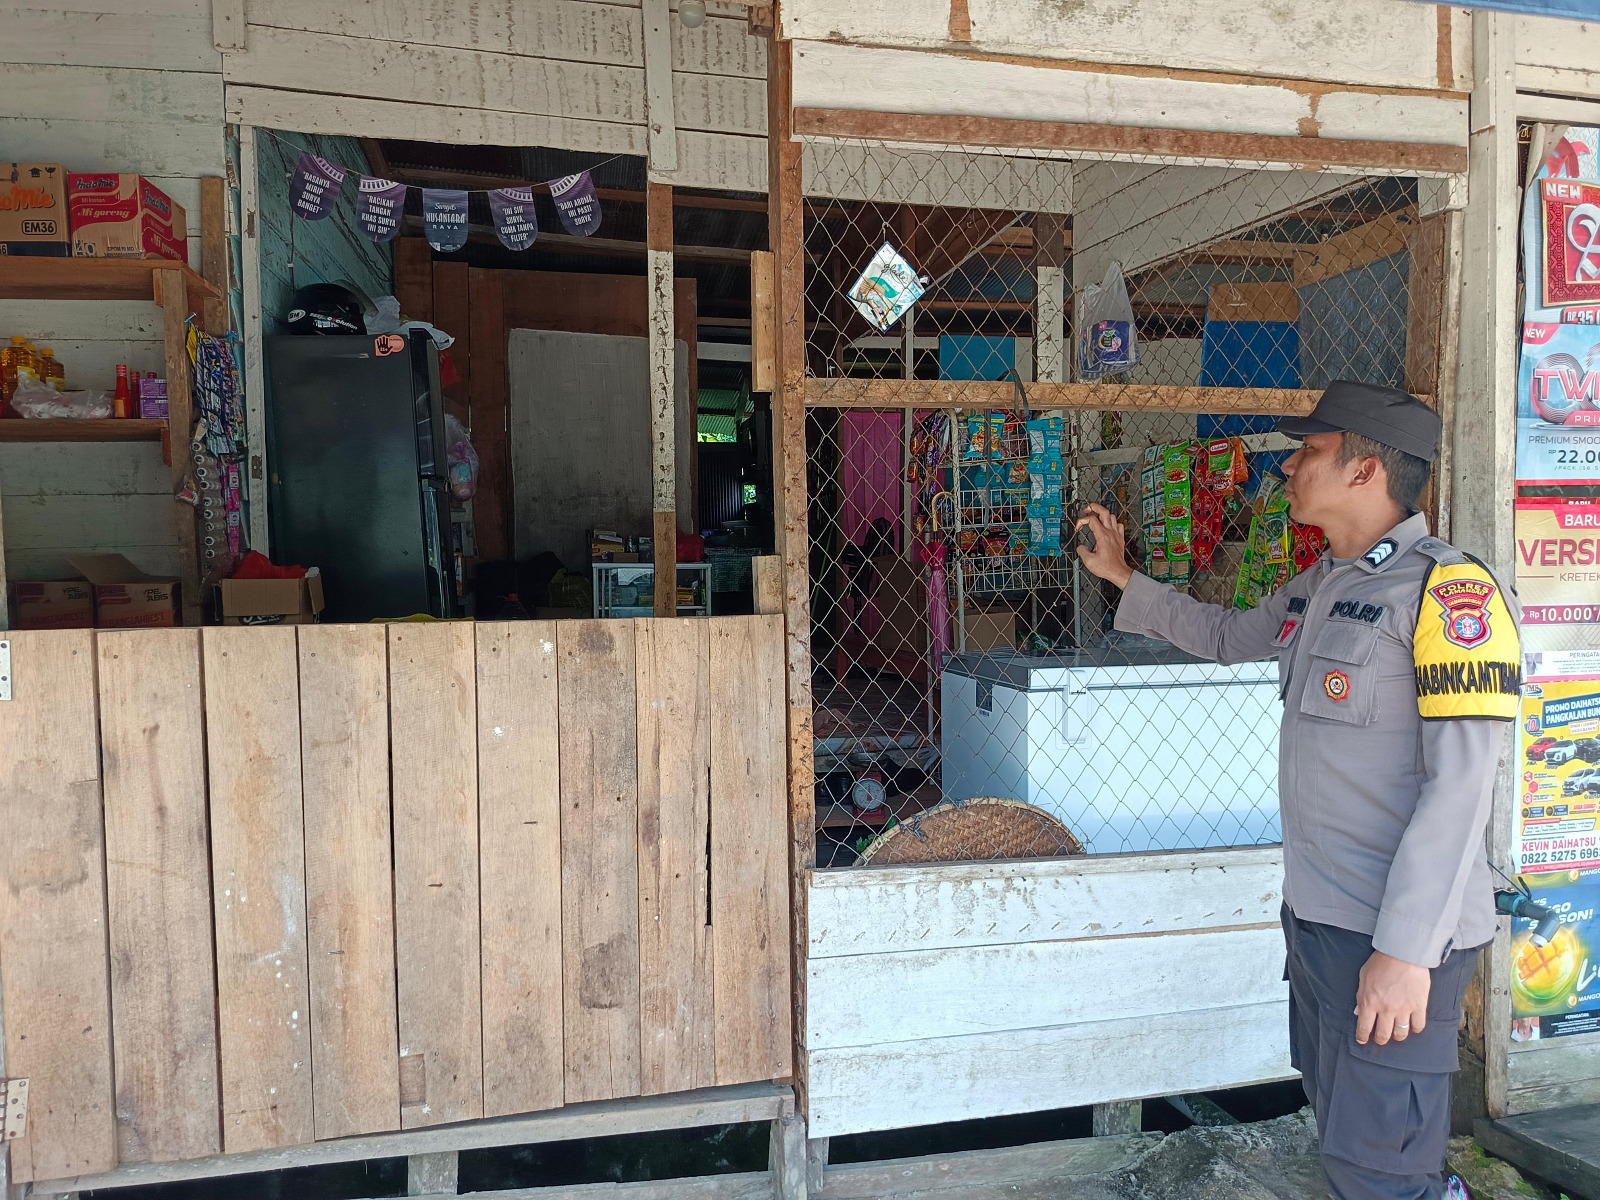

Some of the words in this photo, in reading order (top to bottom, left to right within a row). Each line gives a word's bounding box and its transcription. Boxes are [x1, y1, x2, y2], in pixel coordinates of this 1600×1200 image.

[305, 183, 325, 195] MIRIP
[1545, 182, 1580, 199] NEW
[301, 191, 321, 205] SURYA
[94, 207, 130, 219] goreng
[369, 205, 392, 216] TANGAN
[361, 213, 377, 223] KHAS
[378, 216, 396, 228] SURYA
[426, 212, 466, 224] NUSANTARA
[24, 222, 55, 234] EM36
[367, 223, 377, 232] INI
[1525, 327, 1546, 339] NEW
[1528, 435, 1571, 445] PREMIUM
[1439, 583, 1489, 596] POLRES
[1329, 601, 1384, 623] POLRI
[1529, 610, 1540, 619] Rp
[1545, 702, 1570, 714] PROMO
[1545, 710, 1587, 725] PANGKALAN
[1521, 841, 1549, 852] KEVIN
[1552, 836, 1596, 850] DAIHATSU
[1521, 852, 1547, 864] 0822
[1550, 849, 1577, 862] 5275
[1580, 847, 1600, 859] 696
